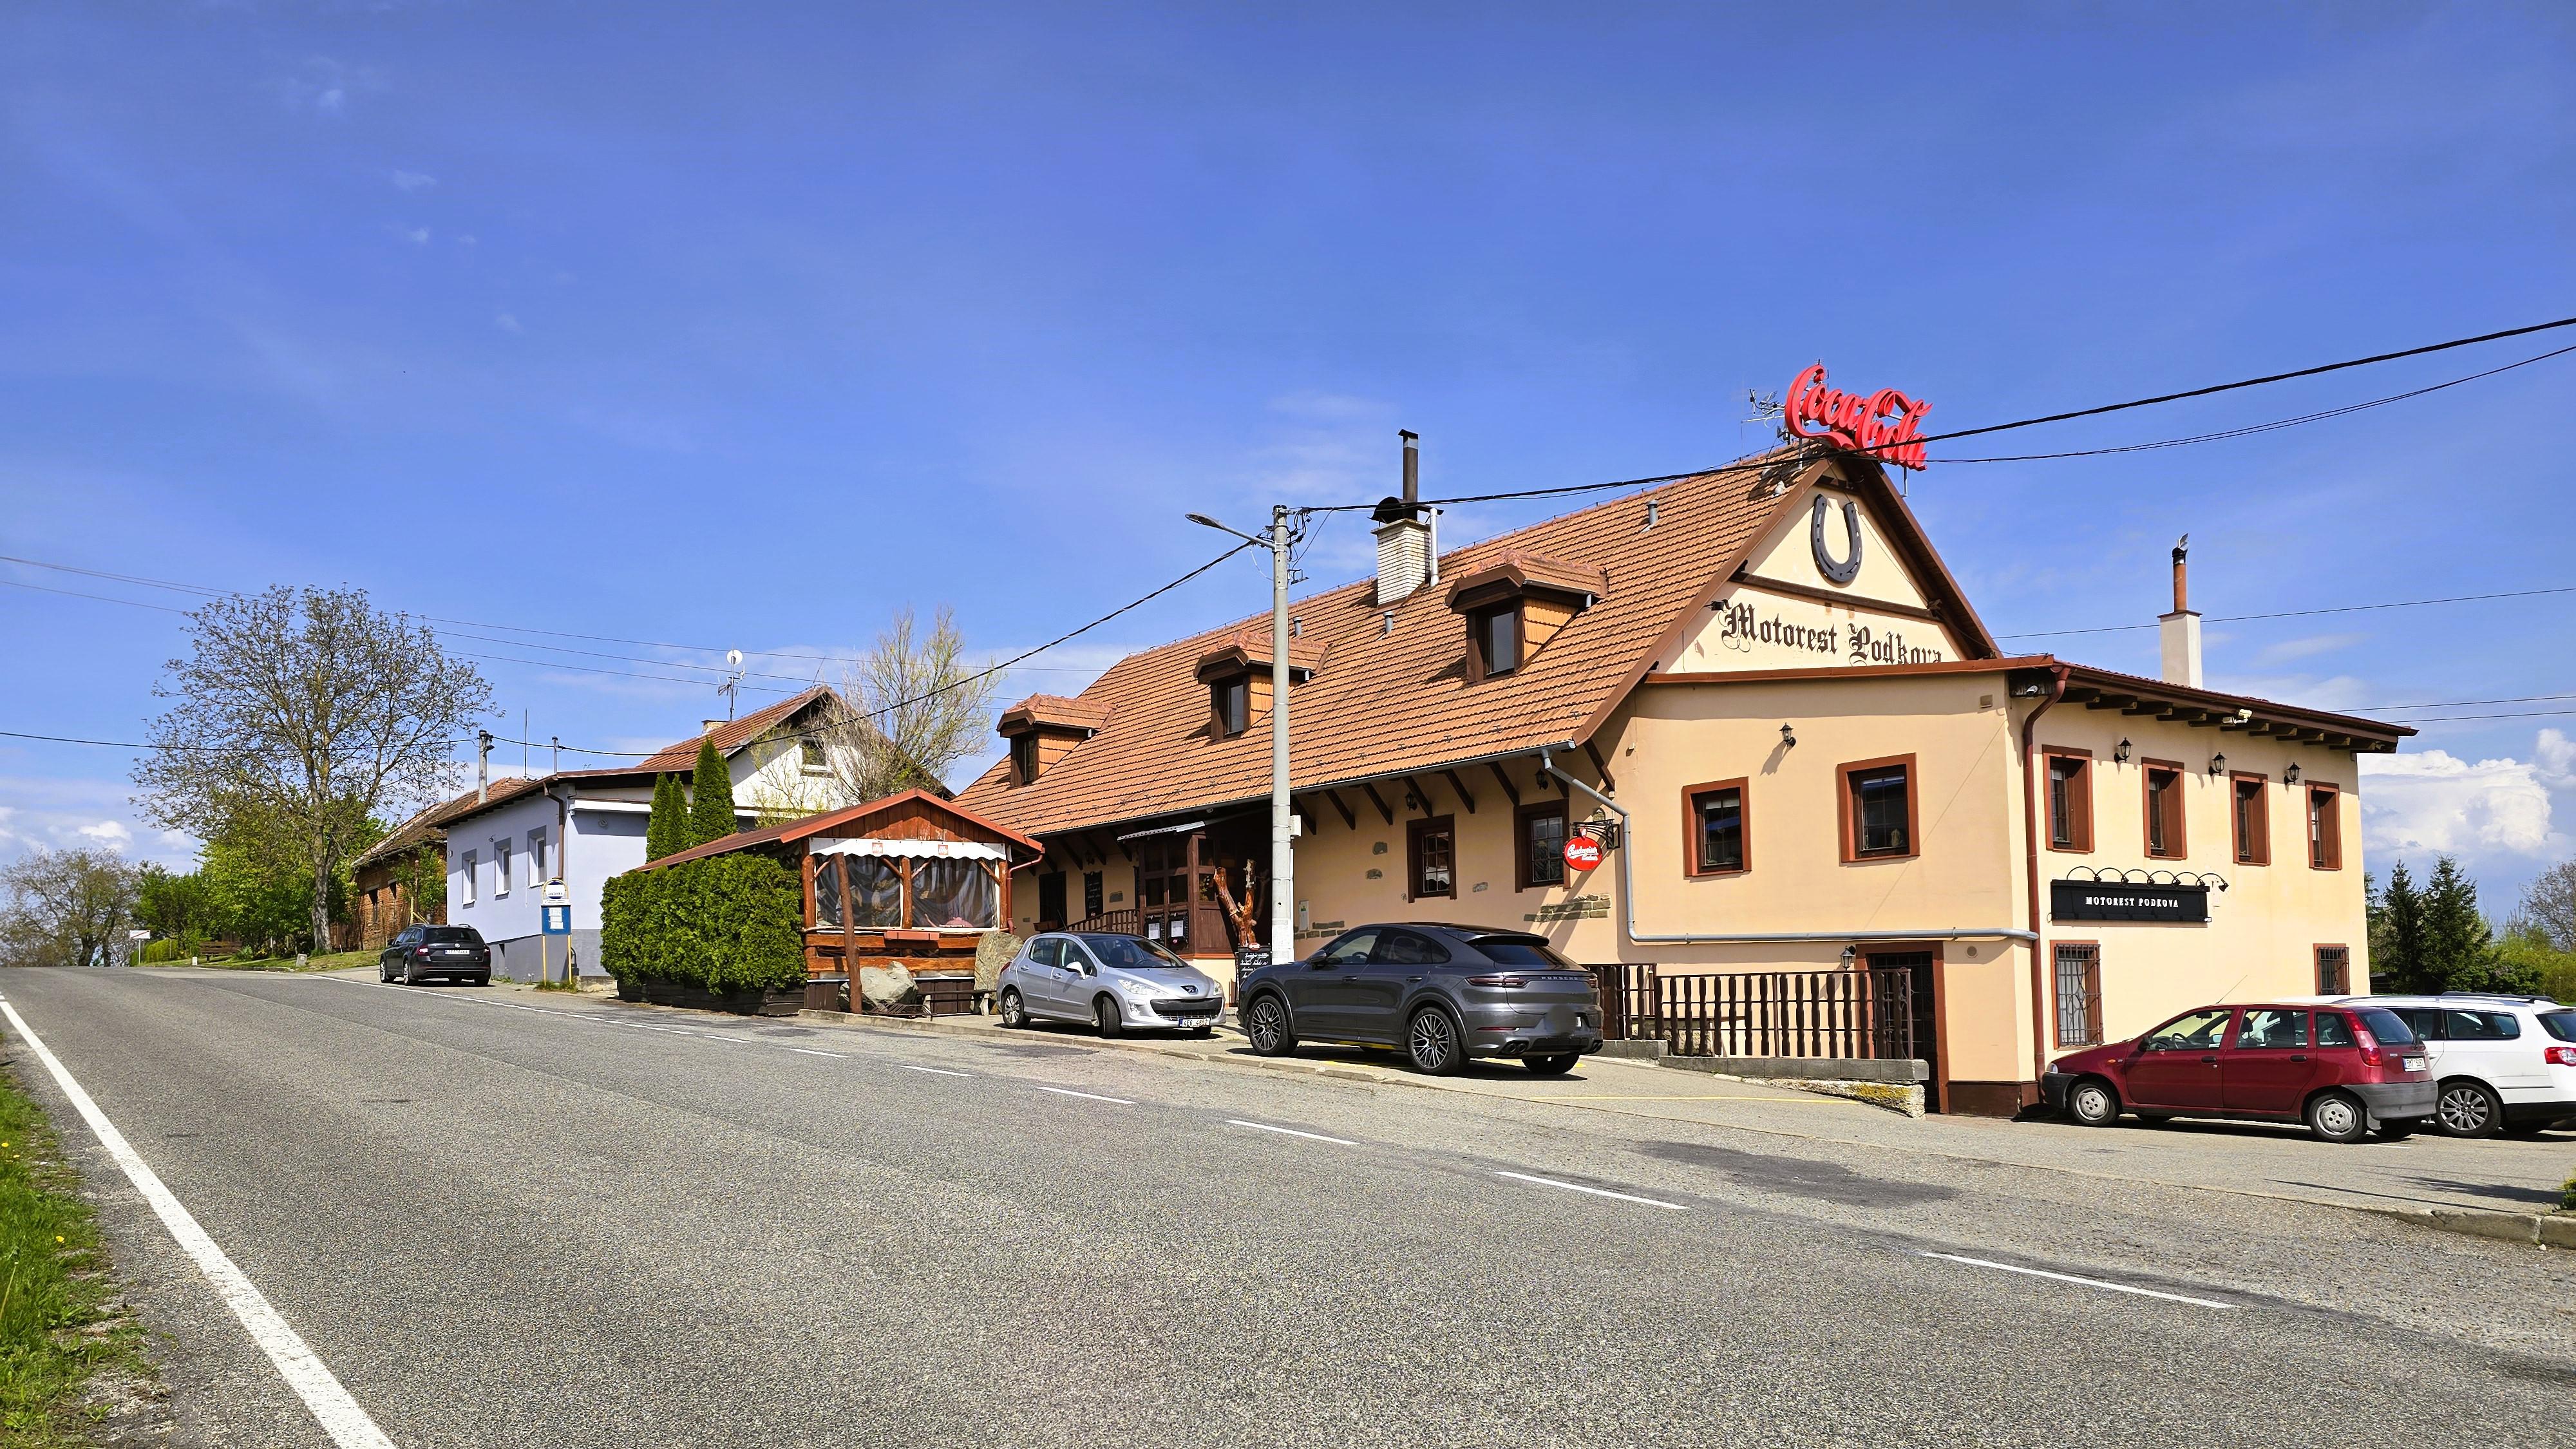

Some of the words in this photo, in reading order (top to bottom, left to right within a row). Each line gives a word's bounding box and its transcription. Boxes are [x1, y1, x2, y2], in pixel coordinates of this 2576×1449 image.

[1718, 599, 1838, 654] Motorest
[1847, 623, 1943, 667] Podkova
[2085, 896, 2135, 907] MOTOREST
[2138, 898, 2179, 907] PODKOVA
